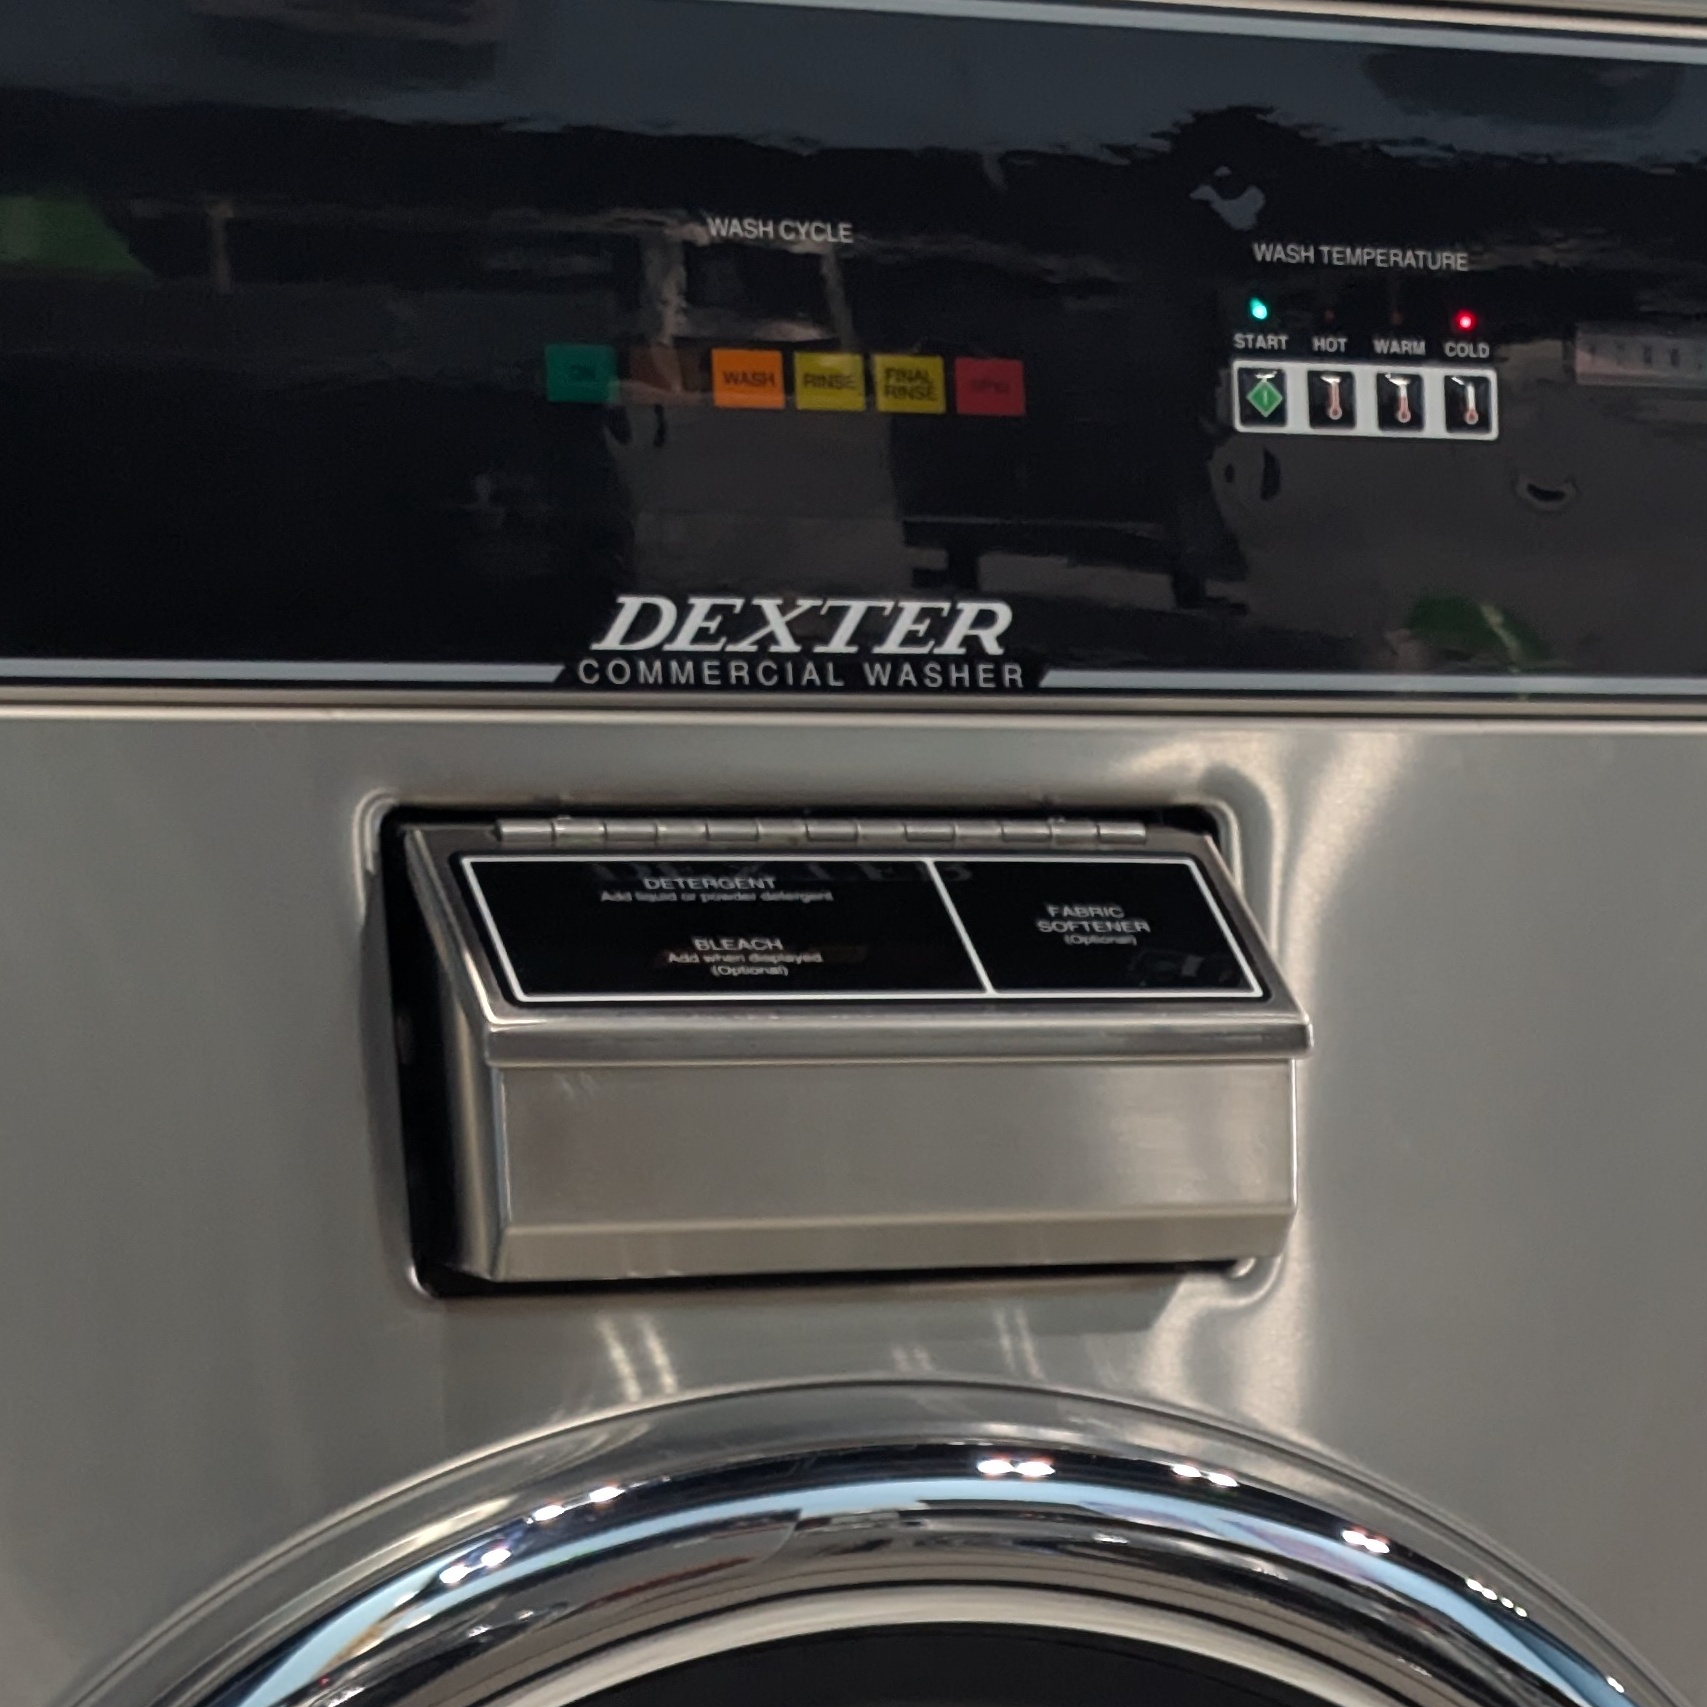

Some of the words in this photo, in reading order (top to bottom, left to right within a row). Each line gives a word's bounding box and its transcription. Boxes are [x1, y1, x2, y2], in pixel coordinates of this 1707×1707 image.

[707, 217, 774, 241] WASH
[778, 219, 854, 244] CYCLE
[1252, 243, 1314, 264] WASH
[1319, 246, 1469, 272] TEMPERATURE
[1234, 332, 1288, 351] START
[1312, 336, 1347, 353] HOT
[1373, 337, 1426, 355] WARM
[1443, 341, 1490, 359] COLD
[723, 370, 775, 387] WASH
[803, 373, 855, 391] RINSE
[885, 368, 932, 384] FINAL
[884, 384, 937, 401] RINSE
[590, 595, 1013, 656] DEXTER
[578, 657, 844, 687] COMMERCIAL
[864, 661, 1024, 688] WASHER
[643, 876, 777, 890] DETERGENT
[1045, 903, 1125, 918] FABRIC
[1036, 919, 1151, 933] SOFTENER
[691, 936, 784, 950] BLEACH
